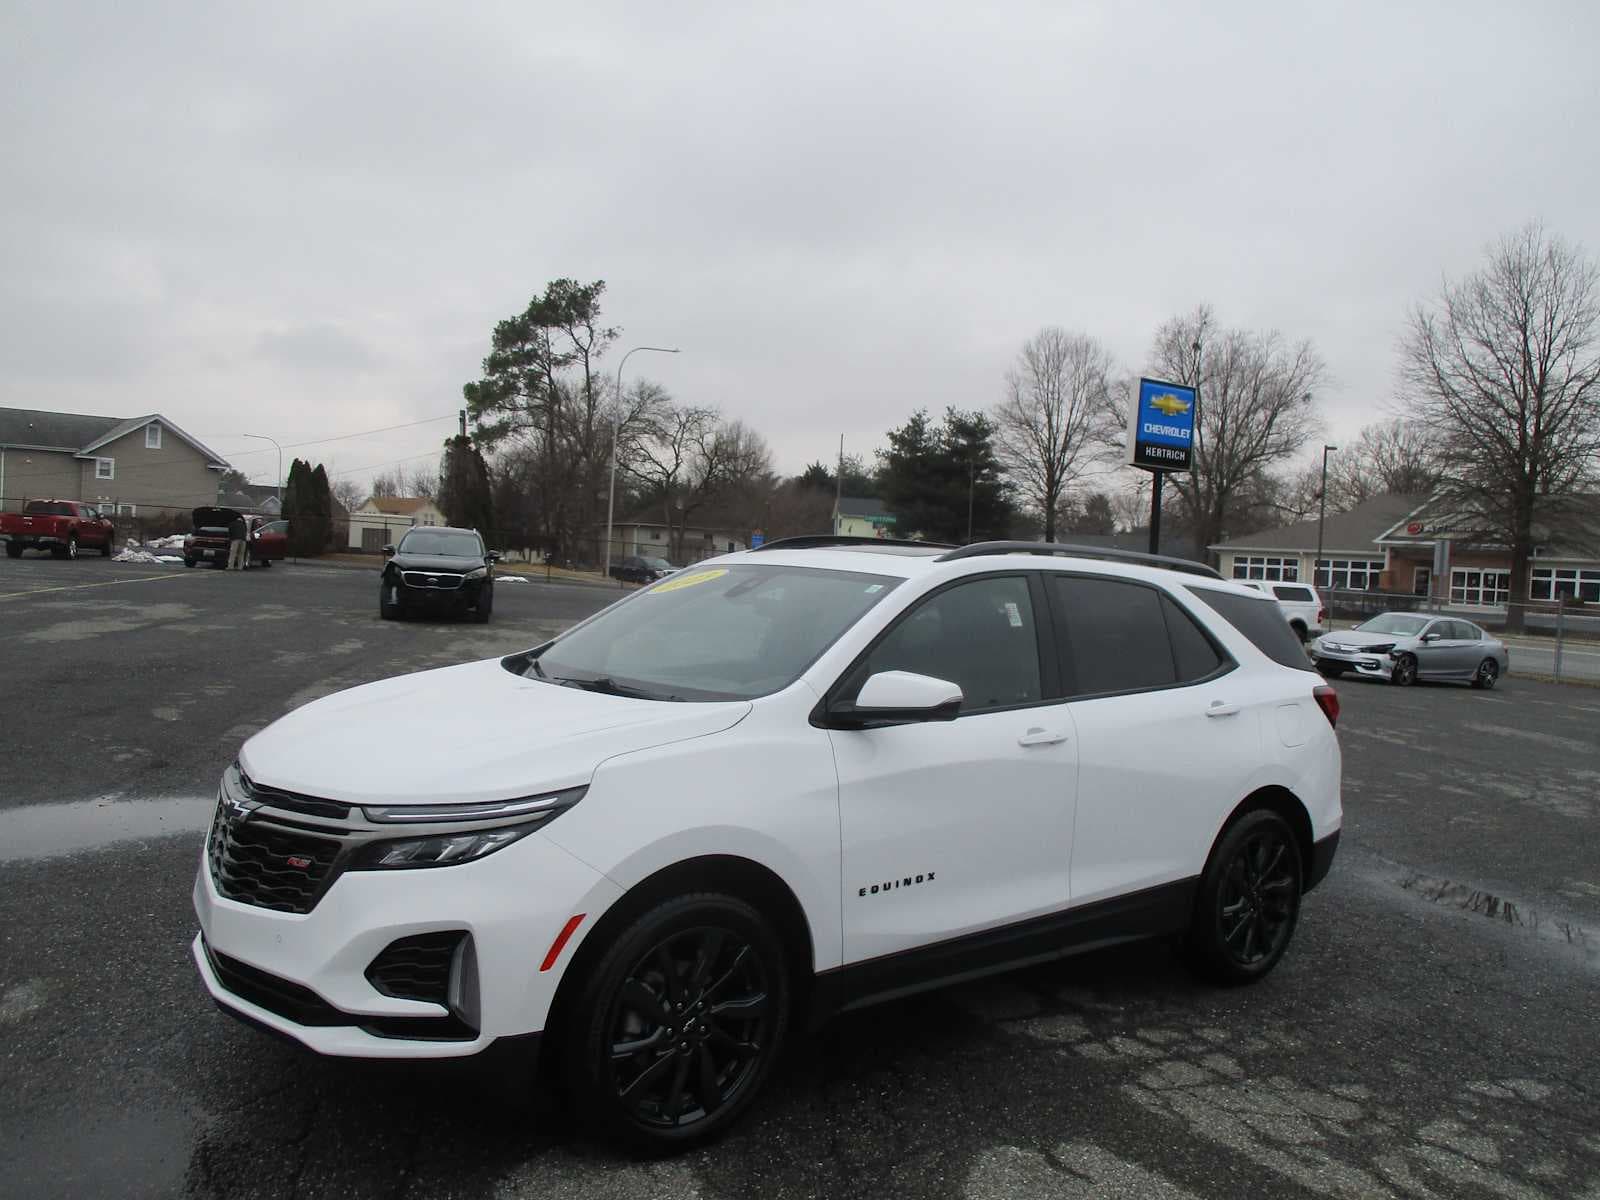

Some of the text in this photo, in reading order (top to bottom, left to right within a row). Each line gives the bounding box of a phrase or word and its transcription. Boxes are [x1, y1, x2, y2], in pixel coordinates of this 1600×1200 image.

[1144, 423, 1191, 439] CHEVROLET
[1145, 446, 1185, 460] HERTRICH
[859, 872, 935, 896] EQUINOX
